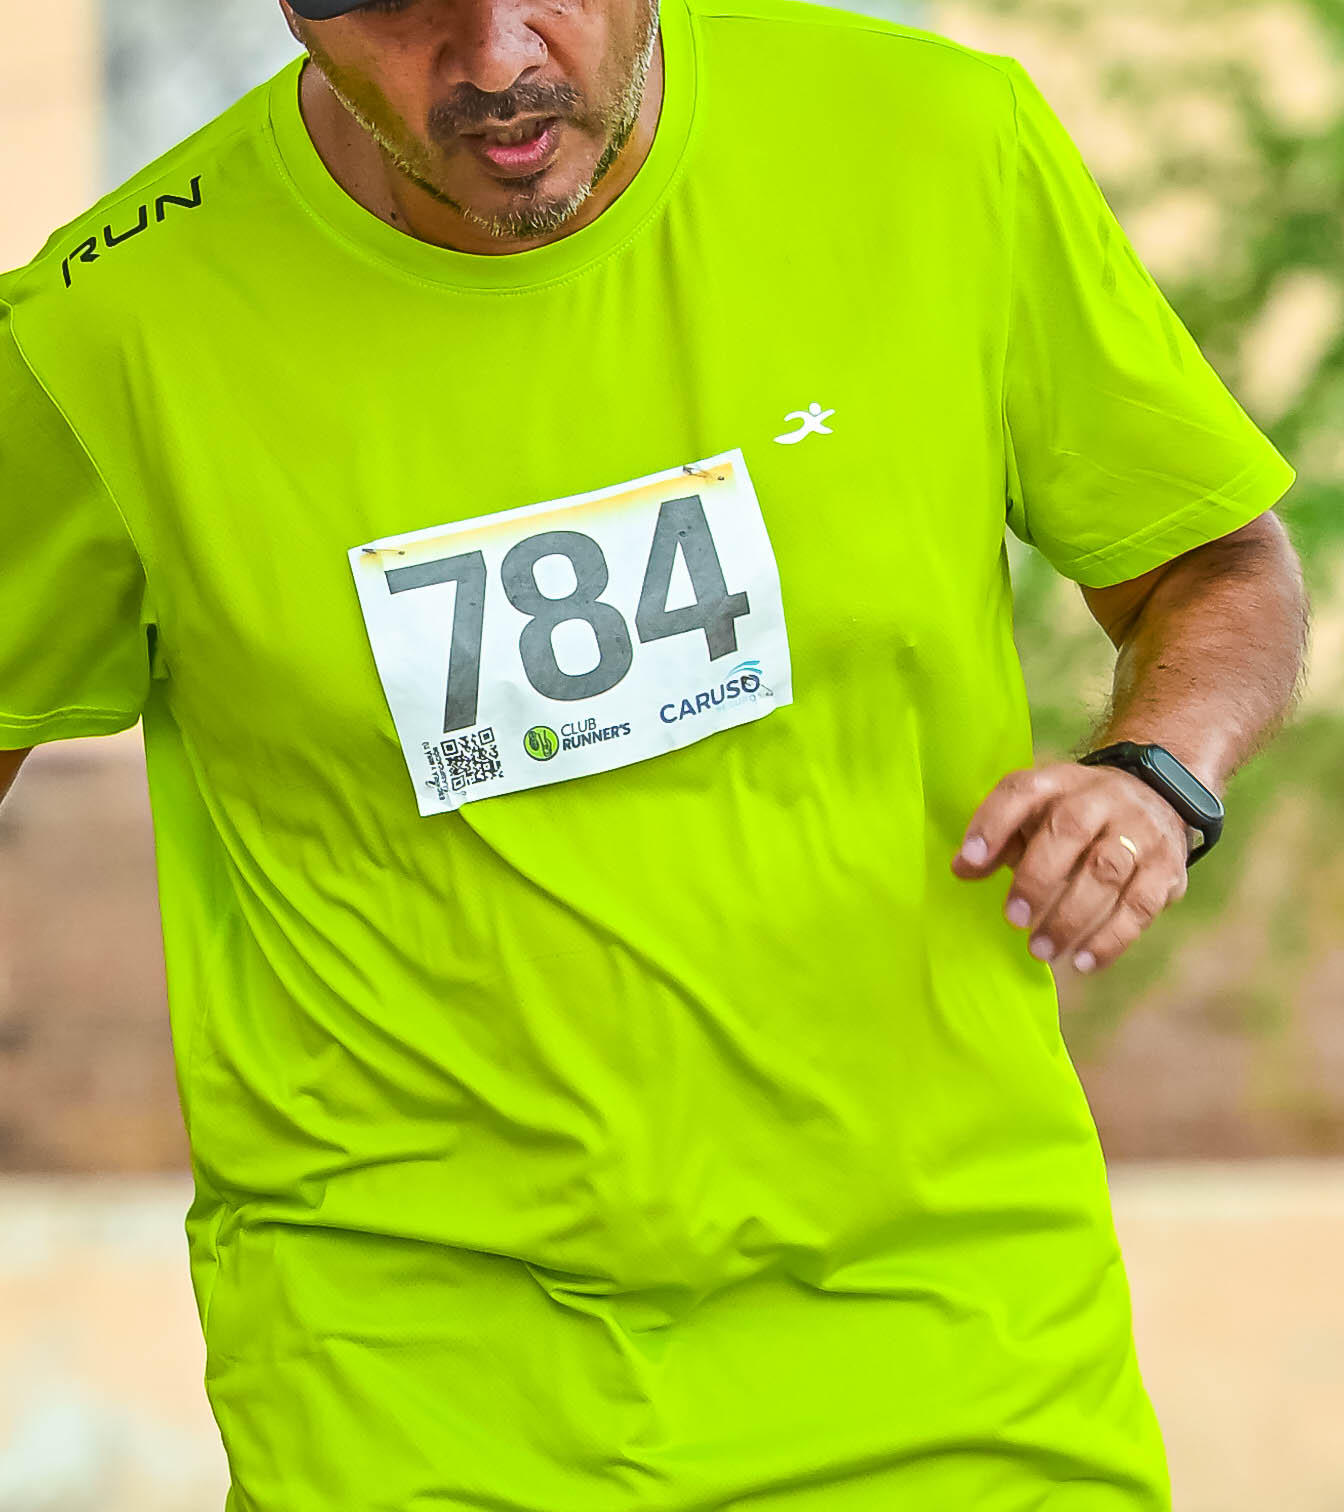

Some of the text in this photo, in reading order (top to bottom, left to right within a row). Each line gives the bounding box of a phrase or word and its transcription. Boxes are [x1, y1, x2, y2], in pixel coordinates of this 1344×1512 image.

[61, 174, 203, 289] RUN
[384, 494, 751, 735] 784
[659, 673, 761, 724] CARUSO
[560, 717, 597, 737] CLUB
[562, 722, 632, 751] RUNNER'S
